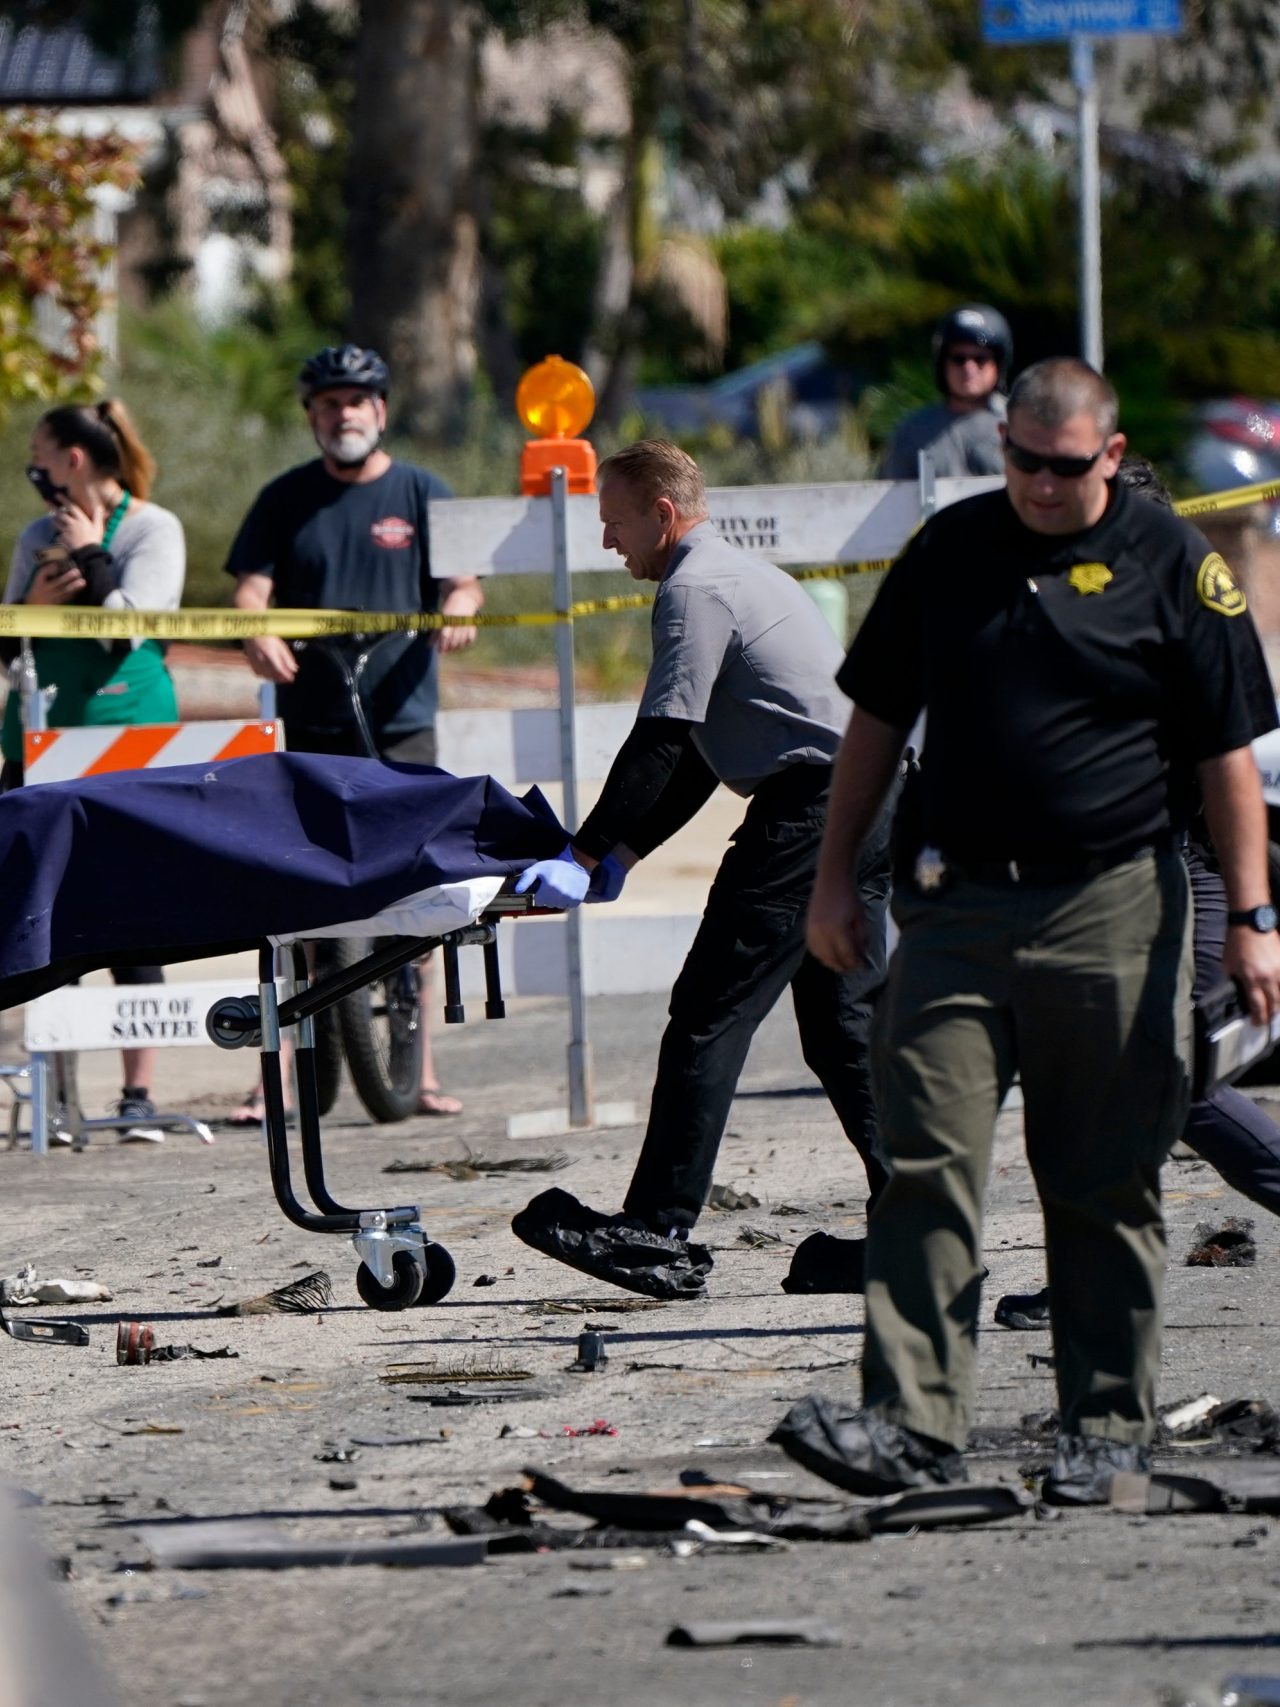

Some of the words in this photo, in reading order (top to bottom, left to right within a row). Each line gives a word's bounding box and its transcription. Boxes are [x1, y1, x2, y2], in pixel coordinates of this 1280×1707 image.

[712, 517, 748, 531] ITY
[756, 517, 776, 530] OF
[62, 611, 129, 635] SHERIFF'S
[166, 612, 185, 635] DO
[190, 613, 218, 635] NOT
[222, 613, 269, 637] CROSS
[117, 998, 161, 1018] CITY
[169, 998, 194, 1016] OF
[112, 1020, 198, 1040] SANTEE
